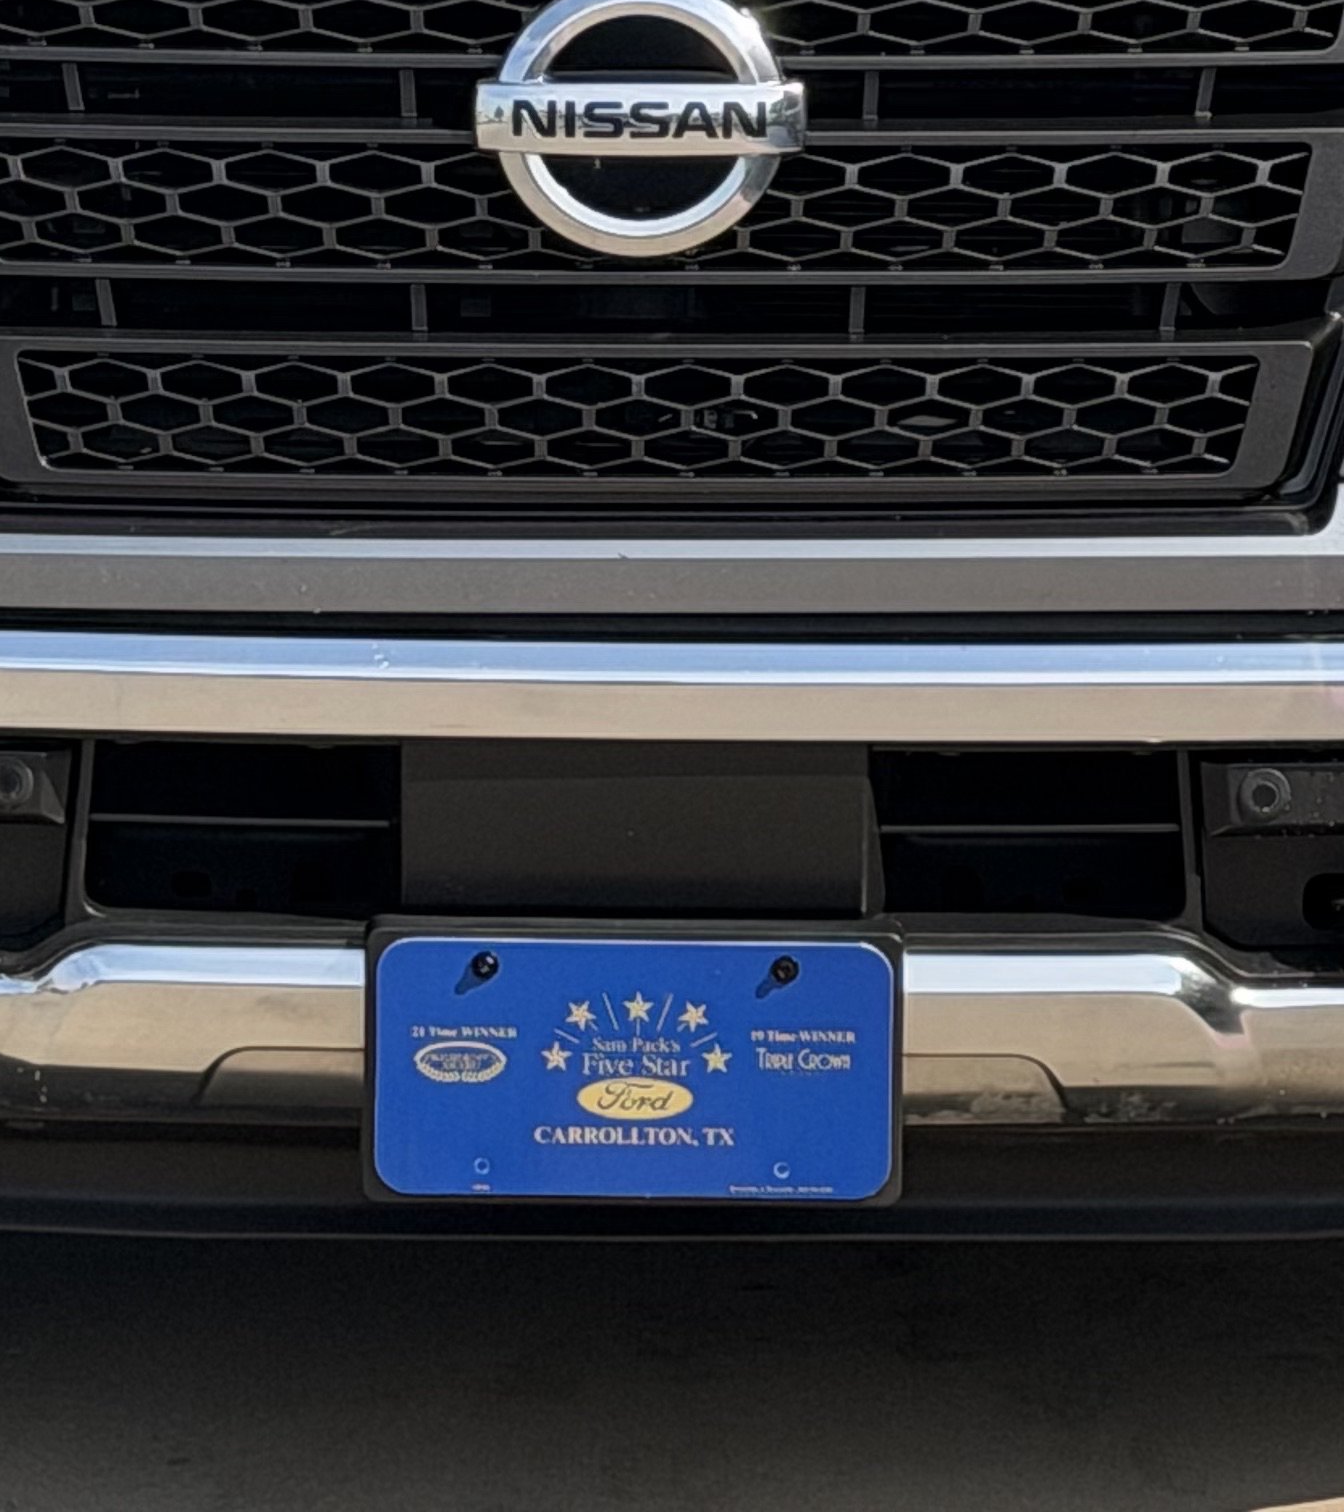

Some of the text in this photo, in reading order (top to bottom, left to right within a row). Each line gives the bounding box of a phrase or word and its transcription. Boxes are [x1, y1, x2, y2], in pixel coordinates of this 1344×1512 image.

[511, 98, 768, 139] NISSAN
[461, 1025, 518, 1039] WINNER
[799, 1029, 856, 1044] WINNER
[592, 1037, 681, 1054] Sam Pack's
[582, 1052, 692, 1077] Five Star
[597, 1081, 674, 1111] Ford
[533, 1125, 736, 1147] CARROLLTON, TX
